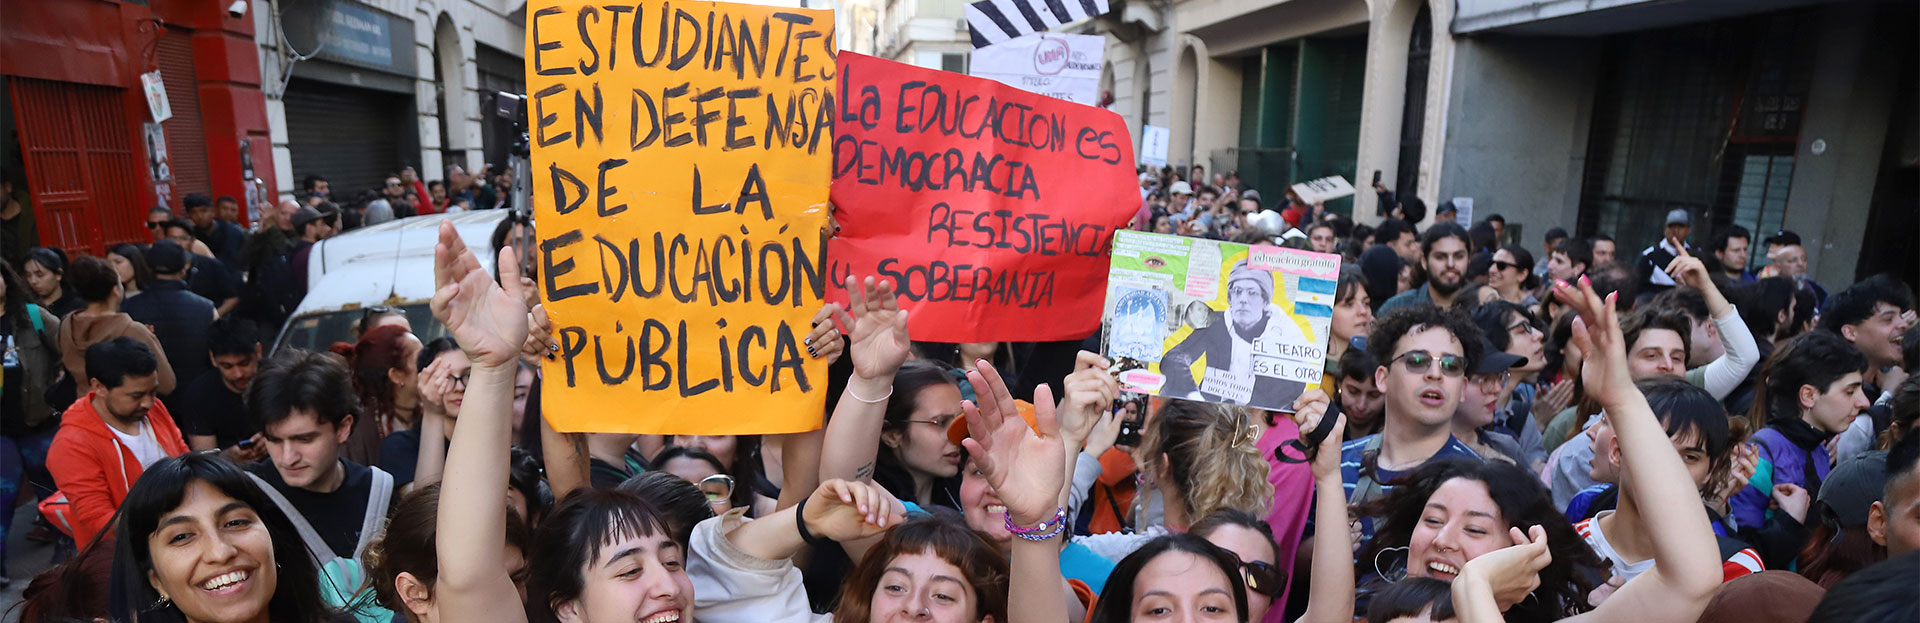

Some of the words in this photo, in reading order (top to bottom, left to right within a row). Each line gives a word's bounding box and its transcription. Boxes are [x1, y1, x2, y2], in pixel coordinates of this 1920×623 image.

[533, 2, 837, 82] ESTUDIANTES
[533, 81, 604, 148] EN
[631, 81, 836, 155] DEFENSA
[841, 63, 881, 131] La
[896, 80, 1066, 152] EDUCACION
[1076, 126, 1122, 165] es
[549, 158, 628, 217] DE
[692, 163, 774, 220] LA
[831, 134, 1041, 201] DEMOCRACIA
[540, 223, 829, 307] EDUCACIÓN
[876, 257, 1056, 309] SOBERANIA
[559, 318, 813, 398] PÚBLICA
[1253, 340, 1268, 354] EL
[1275, 342, 1322, 360] TEATRO
[1253, 360, 1269, 374] ES
[1273, 363, 1289, 378] EL
[1295, 366, 1322, 382] OTRO
